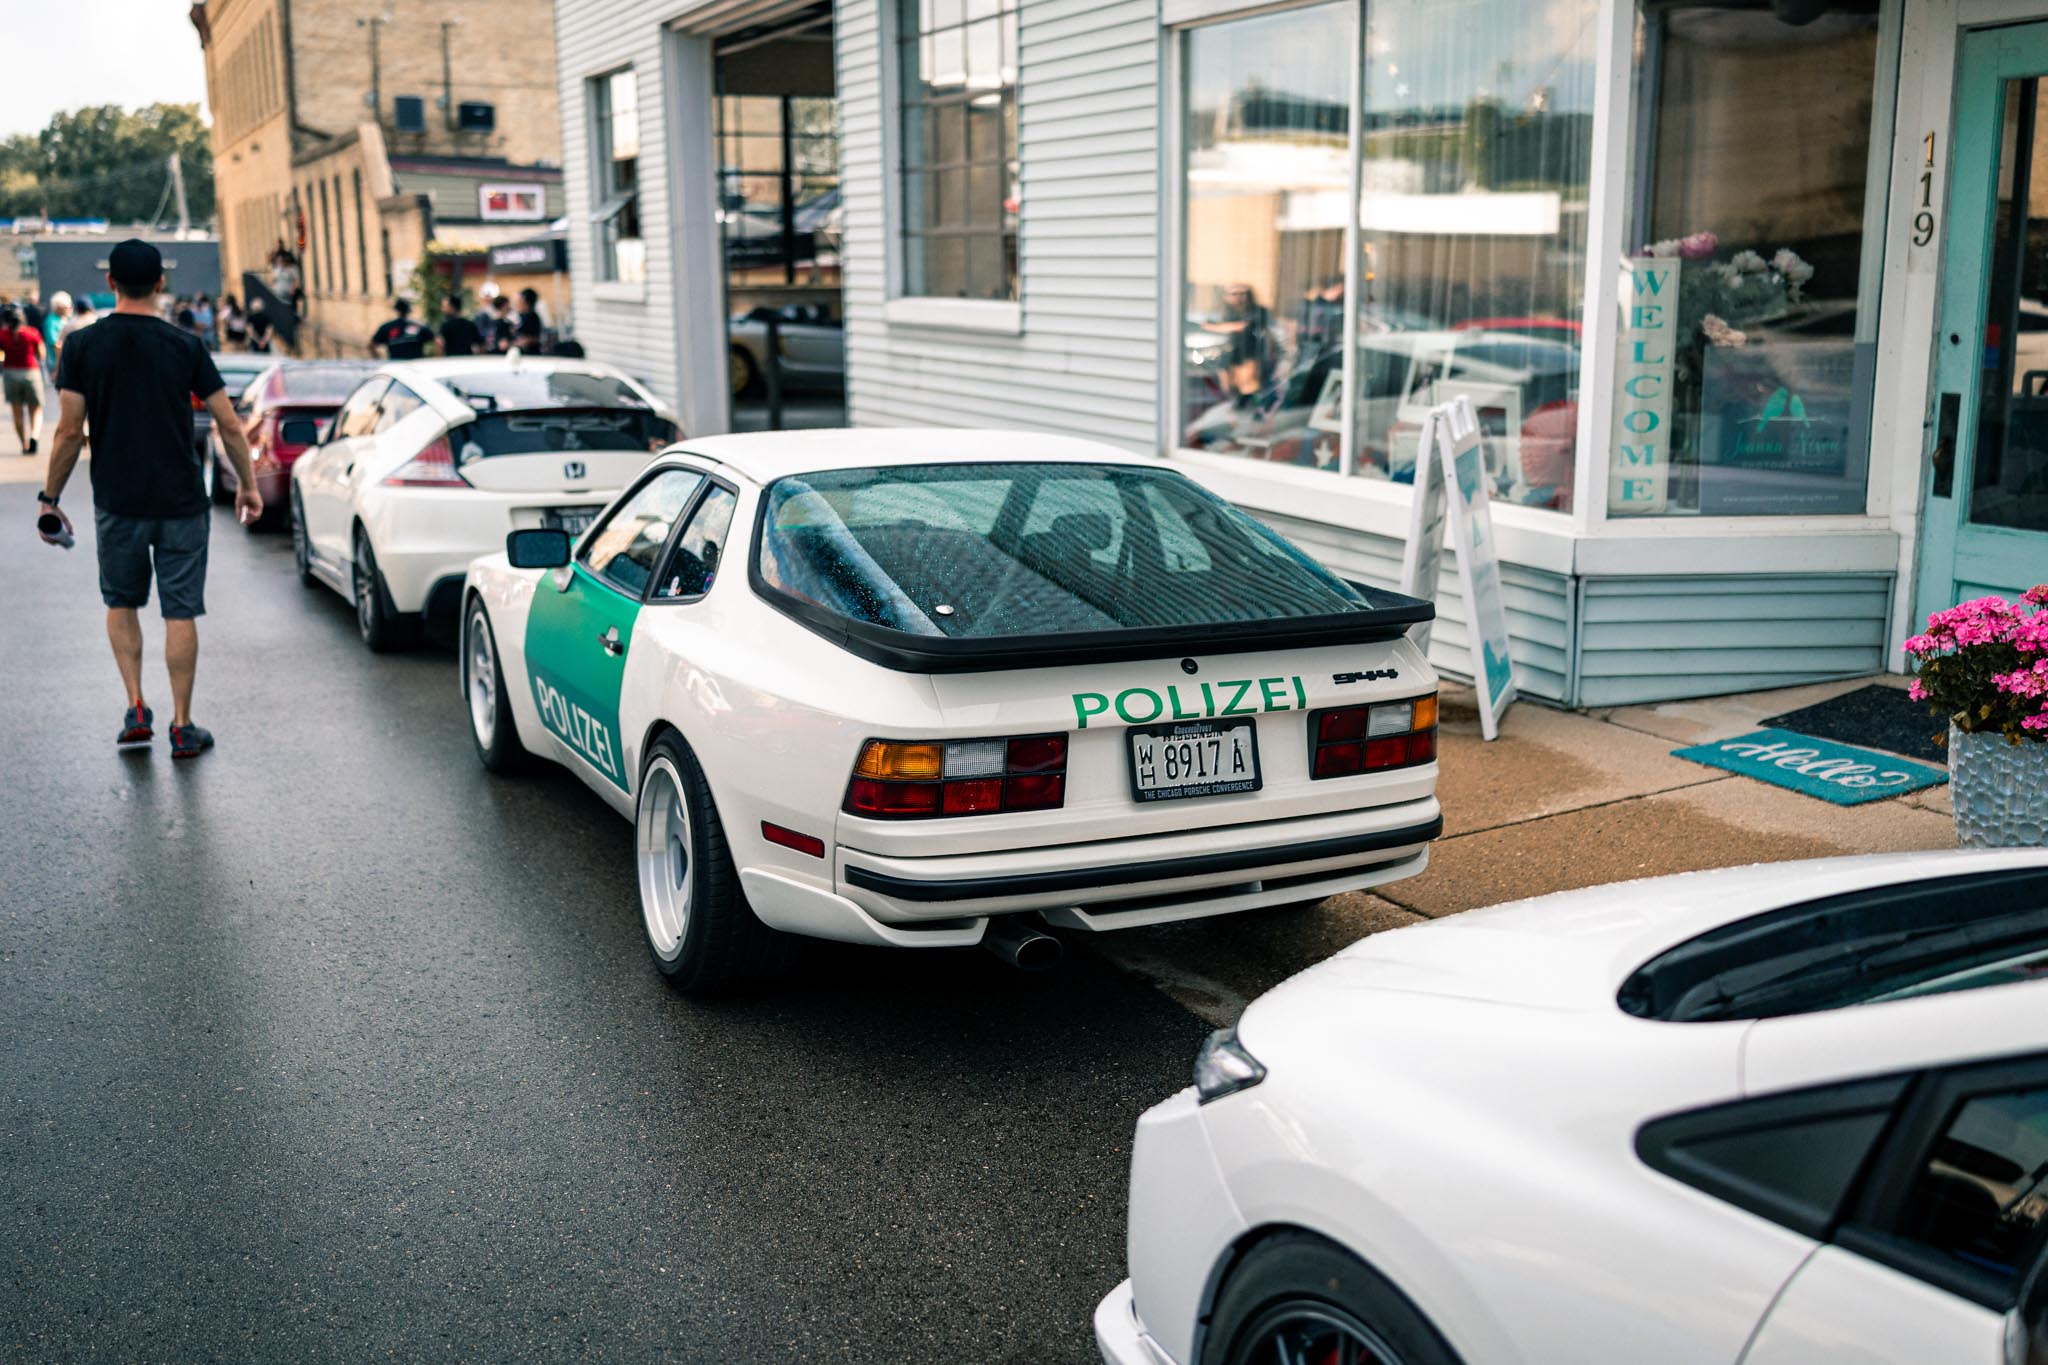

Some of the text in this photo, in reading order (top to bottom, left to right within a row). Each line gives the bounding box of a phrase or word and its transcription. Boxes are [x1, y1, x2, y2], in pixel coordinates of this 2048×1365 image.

[1913, 131, 1936, 247] 119
[1619, 270, 1669, 501] WELCOME
[1333, 668, 1399, 685] 944
[535, 676, 618, 778] POLIZEI
[1072, 675, 1307, 729] POLIZEI
[1163, 740, 1221, 780] 8917
[1720, 742, 1910, 788] Hello
[1144, 790, 1156, 800] THE
[1157, 787, 1183, 798] CHICAGO
[1183, 784, 1211, 796] PORSCHE
[1212, 781, 1254, 793] CONVERGENCE
